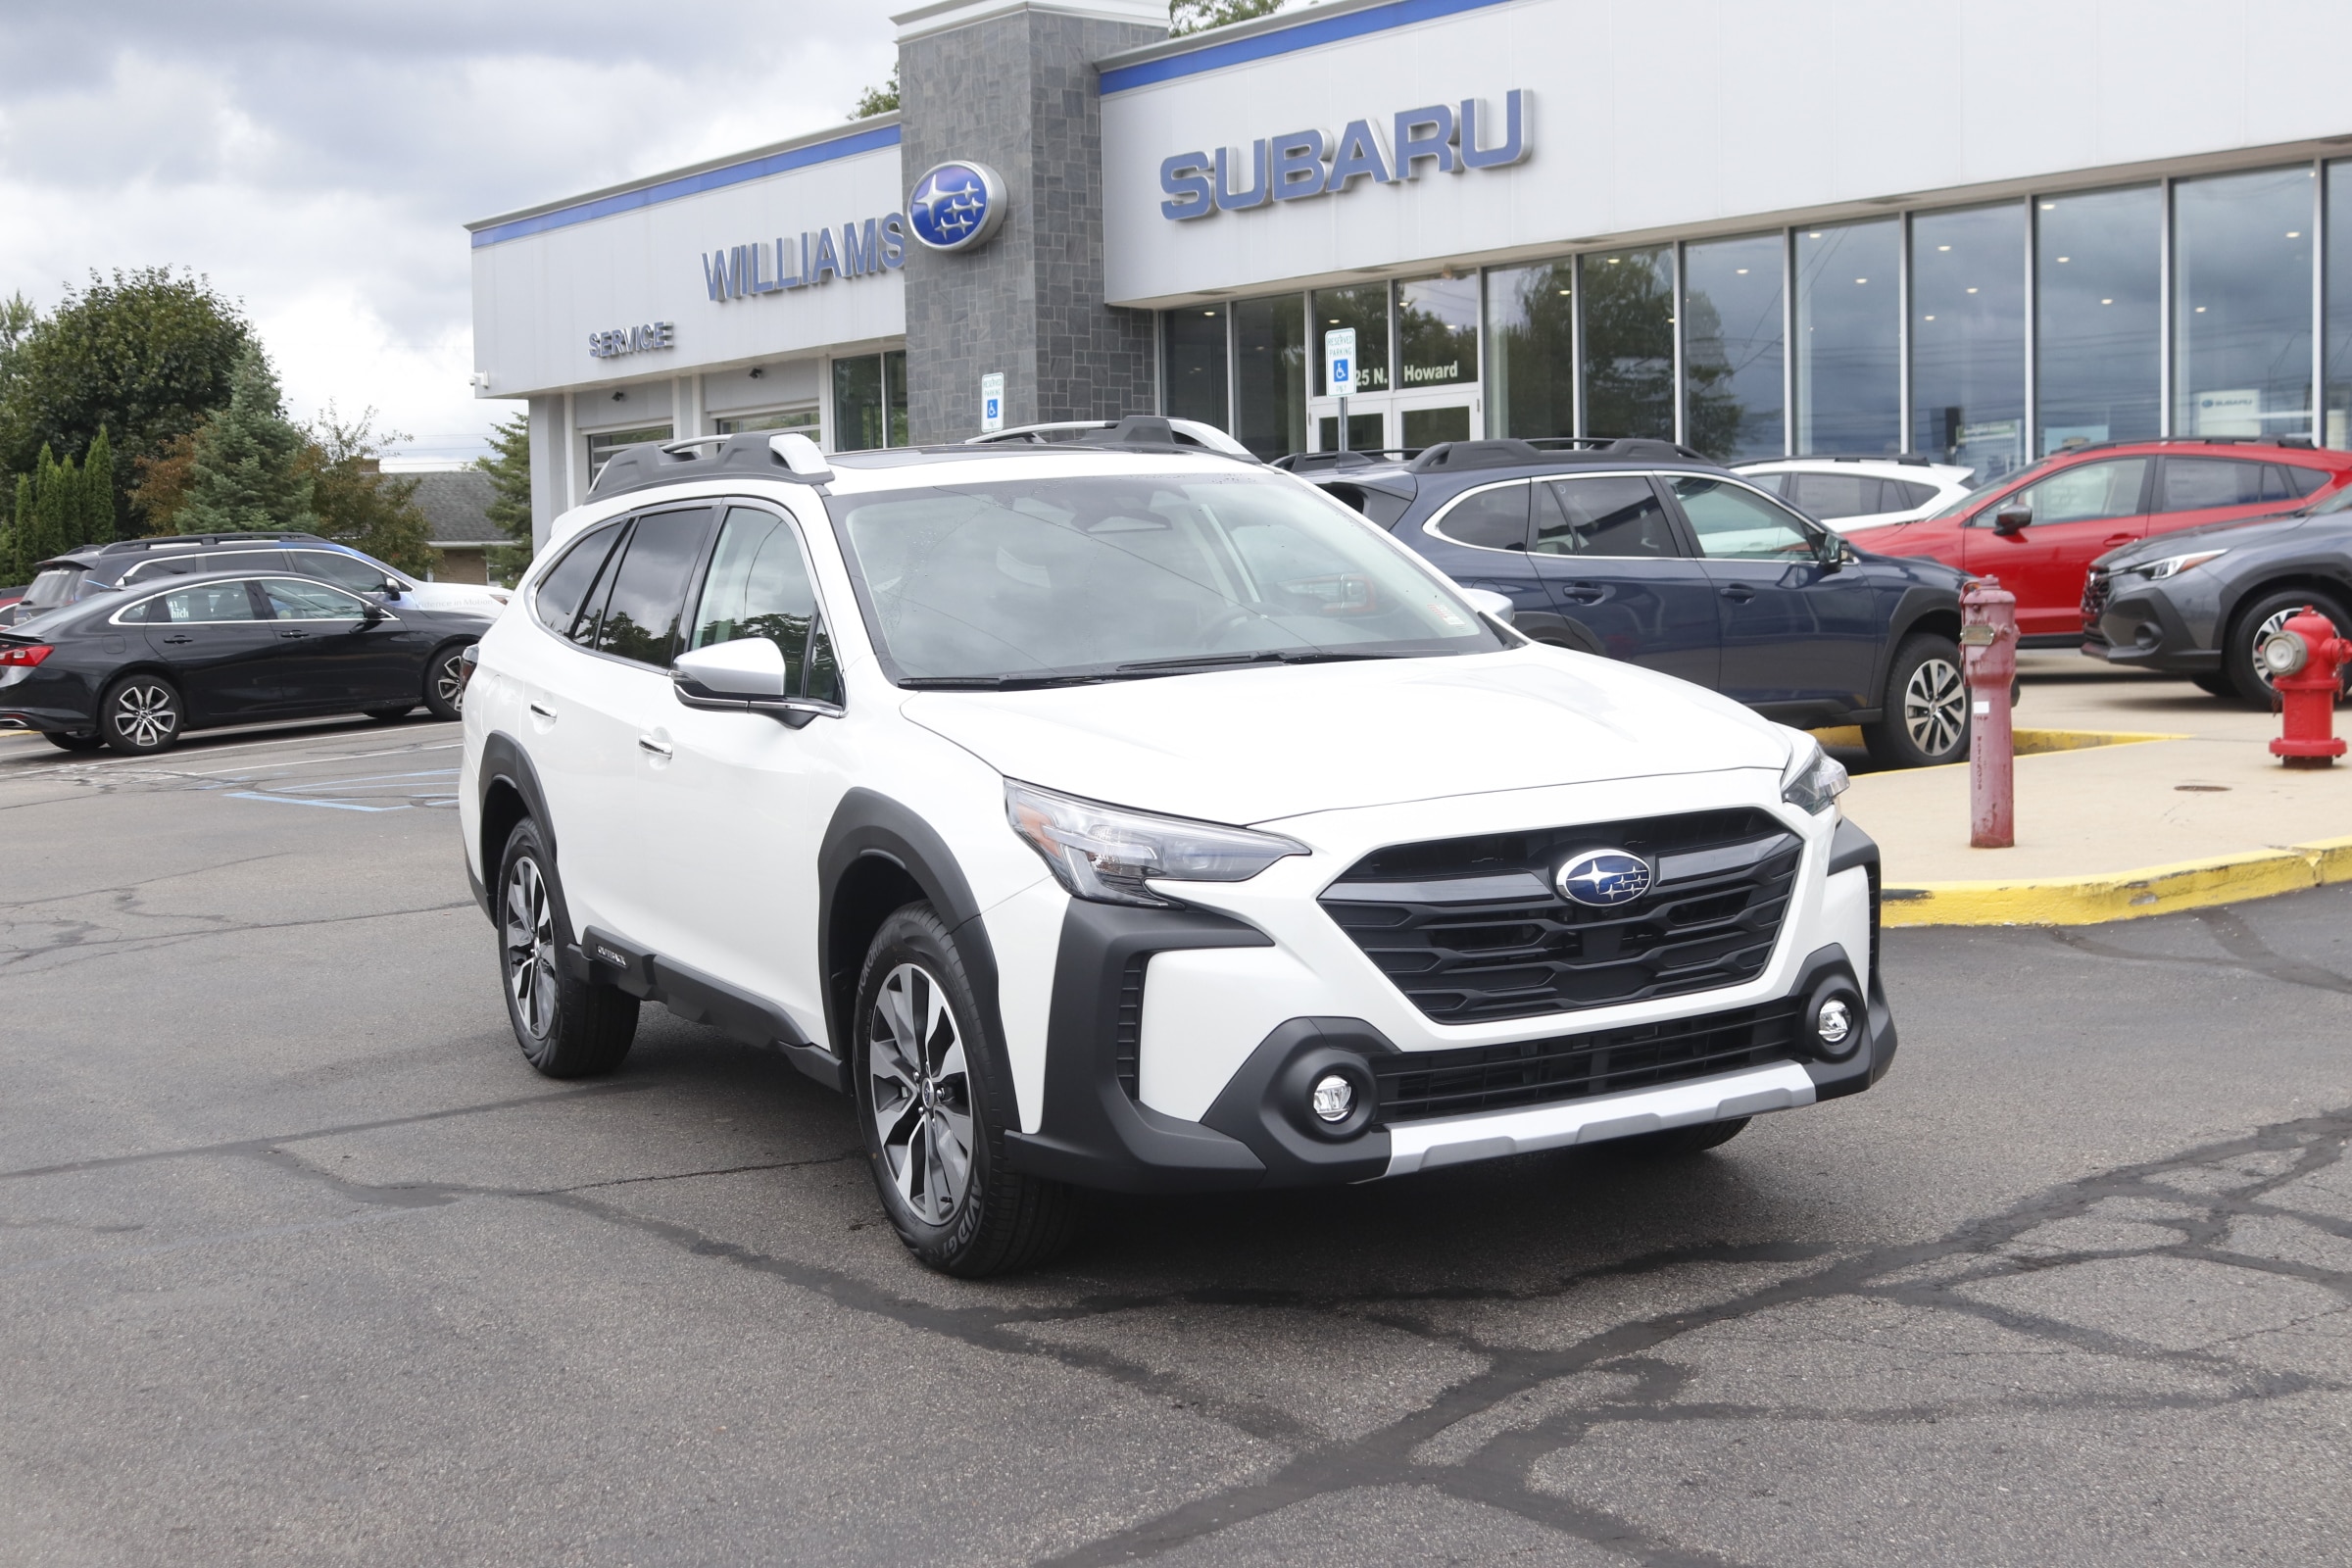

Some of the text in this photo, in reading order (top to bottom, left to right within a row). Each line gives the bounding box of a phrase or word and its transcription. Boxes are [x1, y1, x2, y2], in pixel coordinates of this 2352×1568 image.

[1160, 88, 1532, 220] SUBARU
[701, 212, 905, 302] WILLIAMS
[588, 321, 672, 358] SERVICE
[1373, 368, 1388, 385] N.
[1403, 360, 1458, 382] Howard
[957, 1165, 982, 1245] AVID
